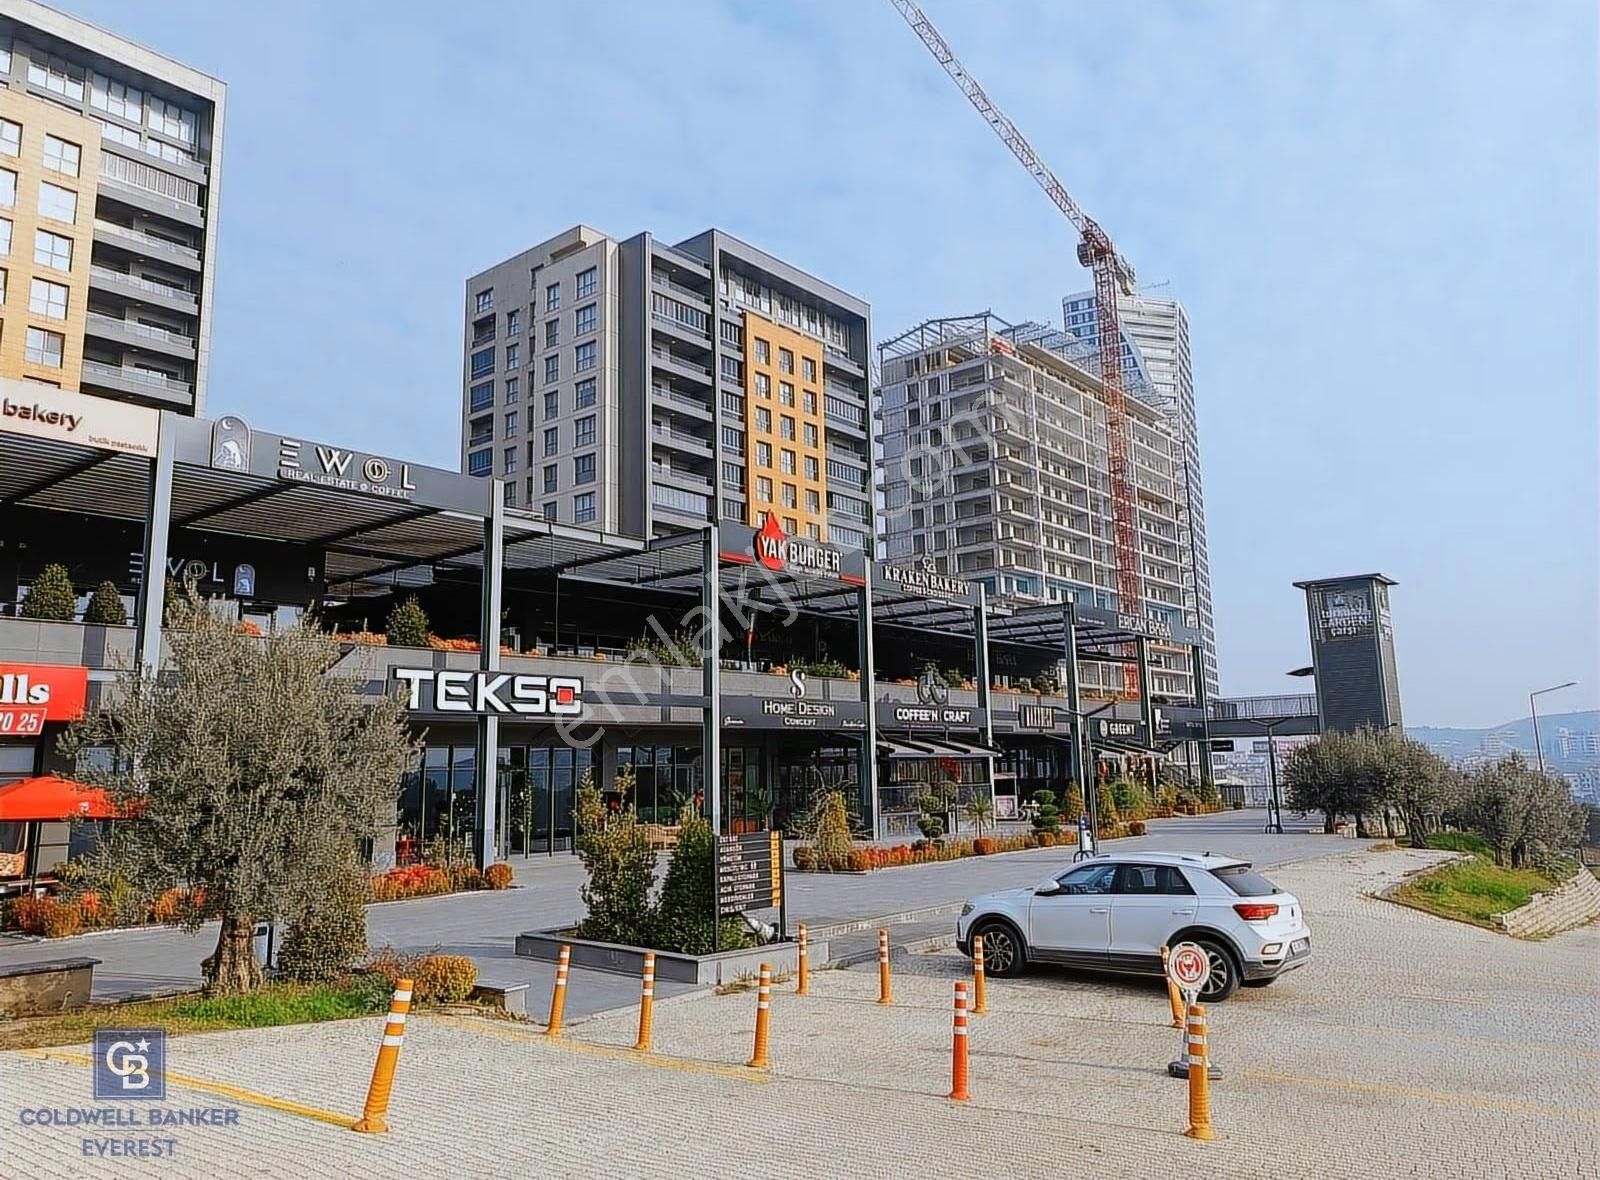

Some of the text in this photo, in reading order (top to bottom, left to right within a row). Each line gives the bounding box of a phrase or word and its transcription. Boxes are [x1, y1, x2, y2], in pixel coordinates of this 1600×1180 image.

[2, 397, 83, 432] bakery
[760, 536, 840, 571] YAK BURGER
[396, 668, 582, 714] TEKSO
[16, 712, 40, 732] 25
[764, 701, 834, 716] HOME DESIGN
[943, 710, 970, 723] CRAFT
